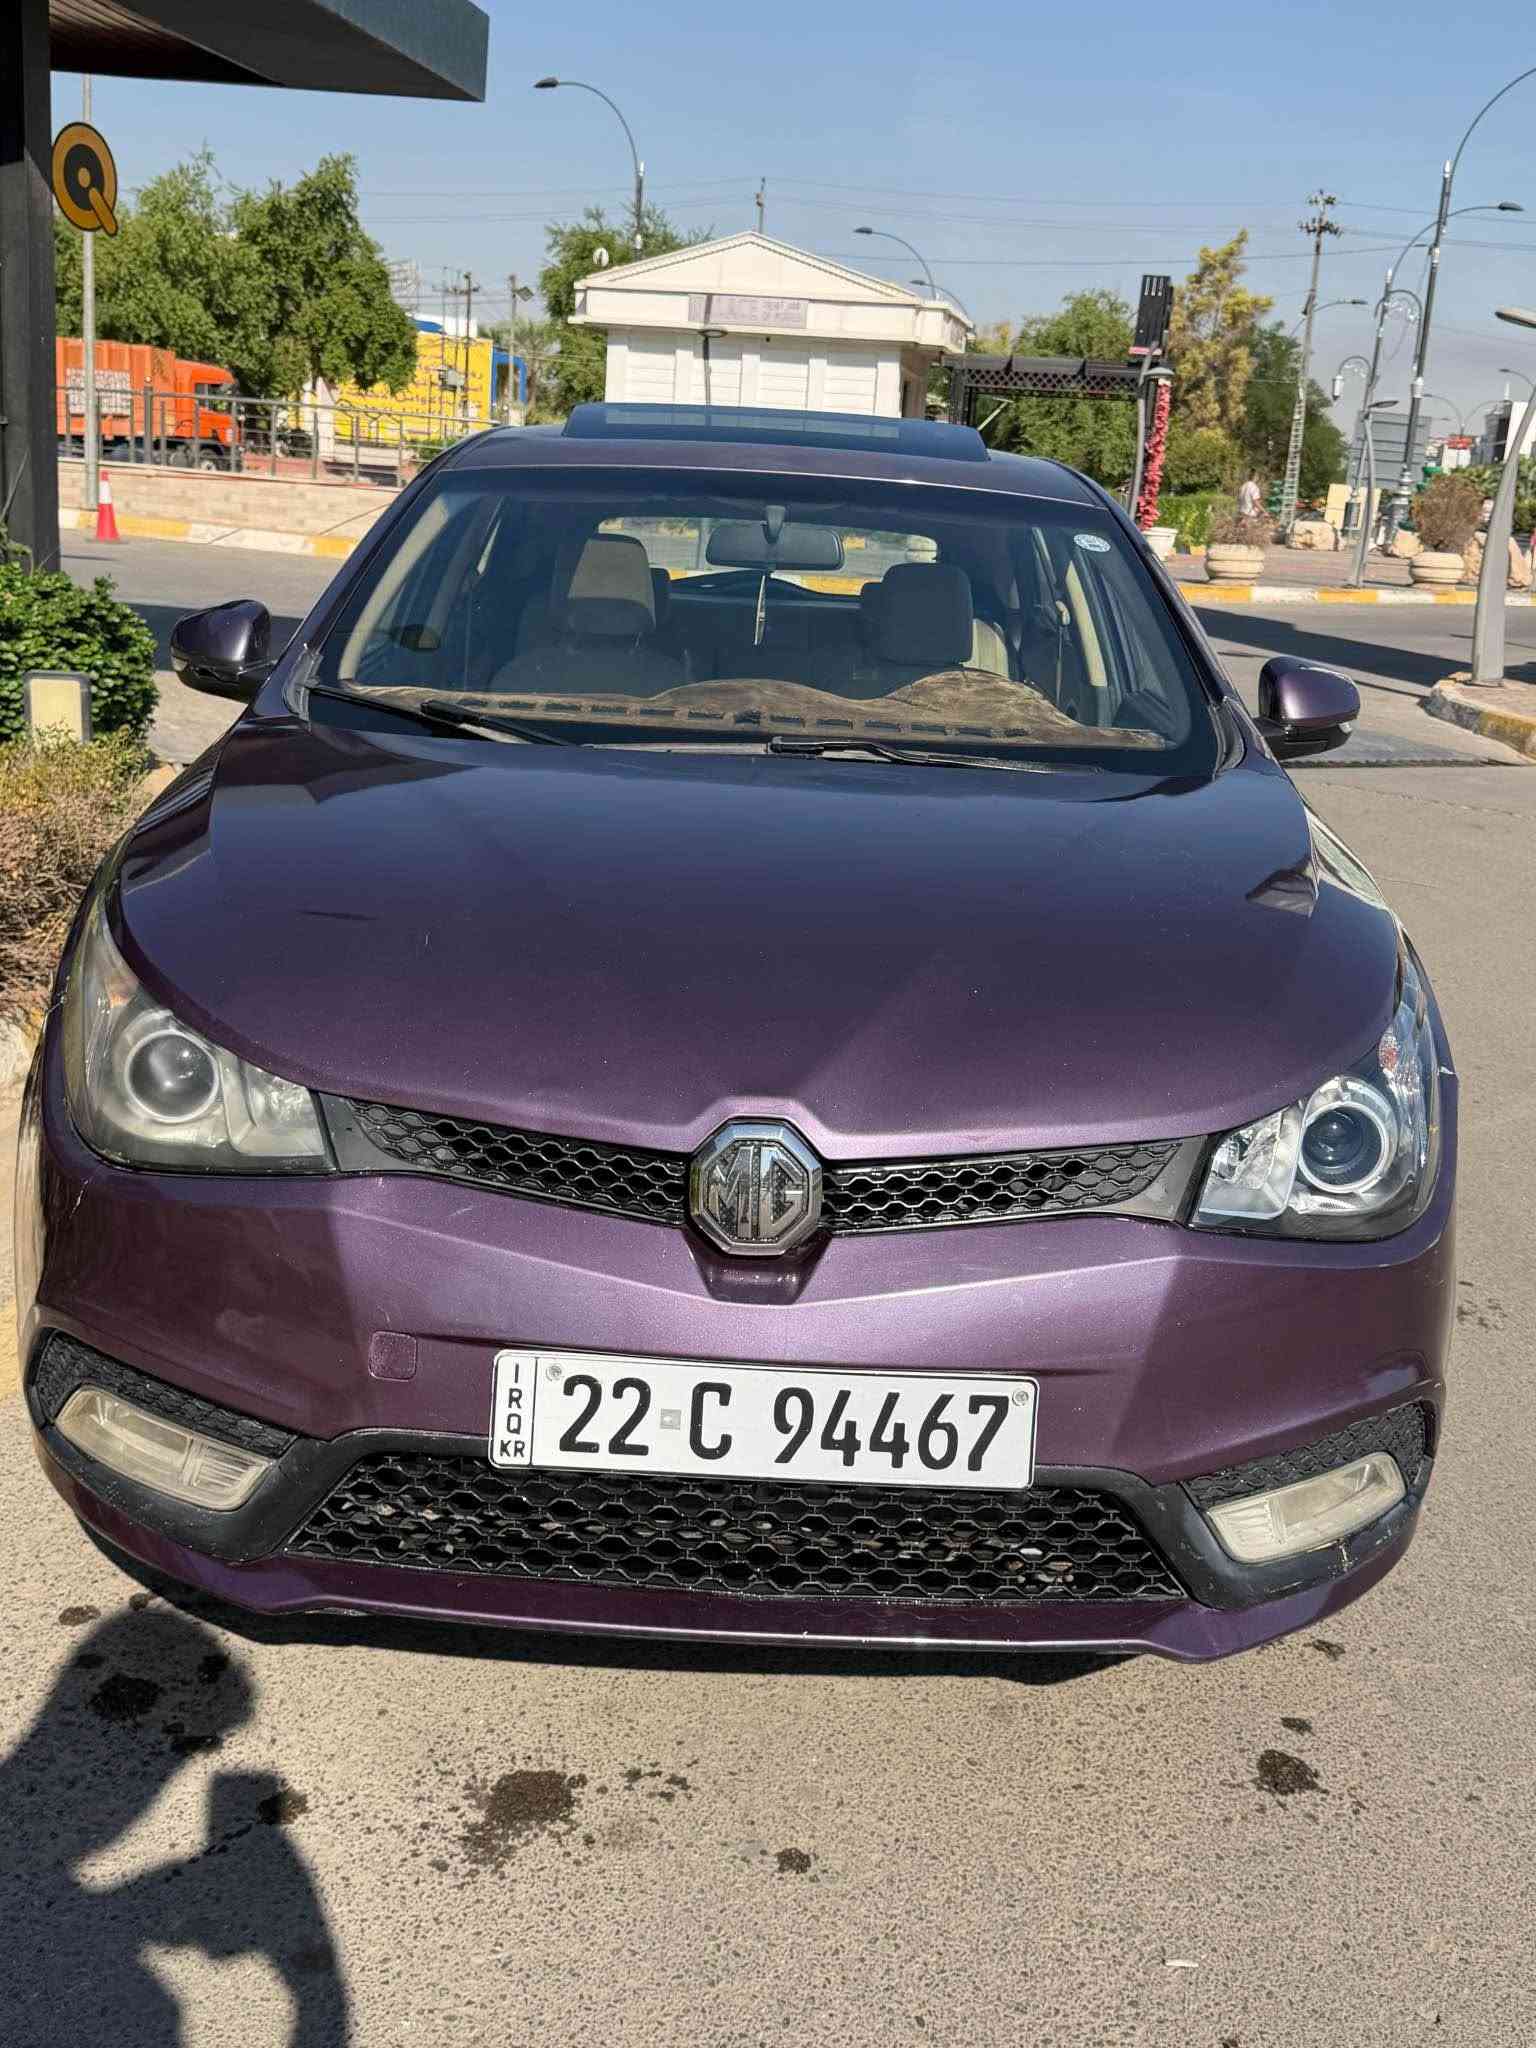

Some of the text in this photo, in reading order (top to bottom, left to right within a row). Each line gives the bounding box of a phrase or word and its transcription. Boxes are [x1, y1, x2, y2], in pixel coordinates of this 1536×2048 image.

[52, 122, 118, 236] Q
[707, 1145, 804, 1238] MG
[506, 1363, 522, 1435] IRQ
[558, 1374, 1010, 1472] 22 C 94467
[499, 1439, 526, 1458] KR
